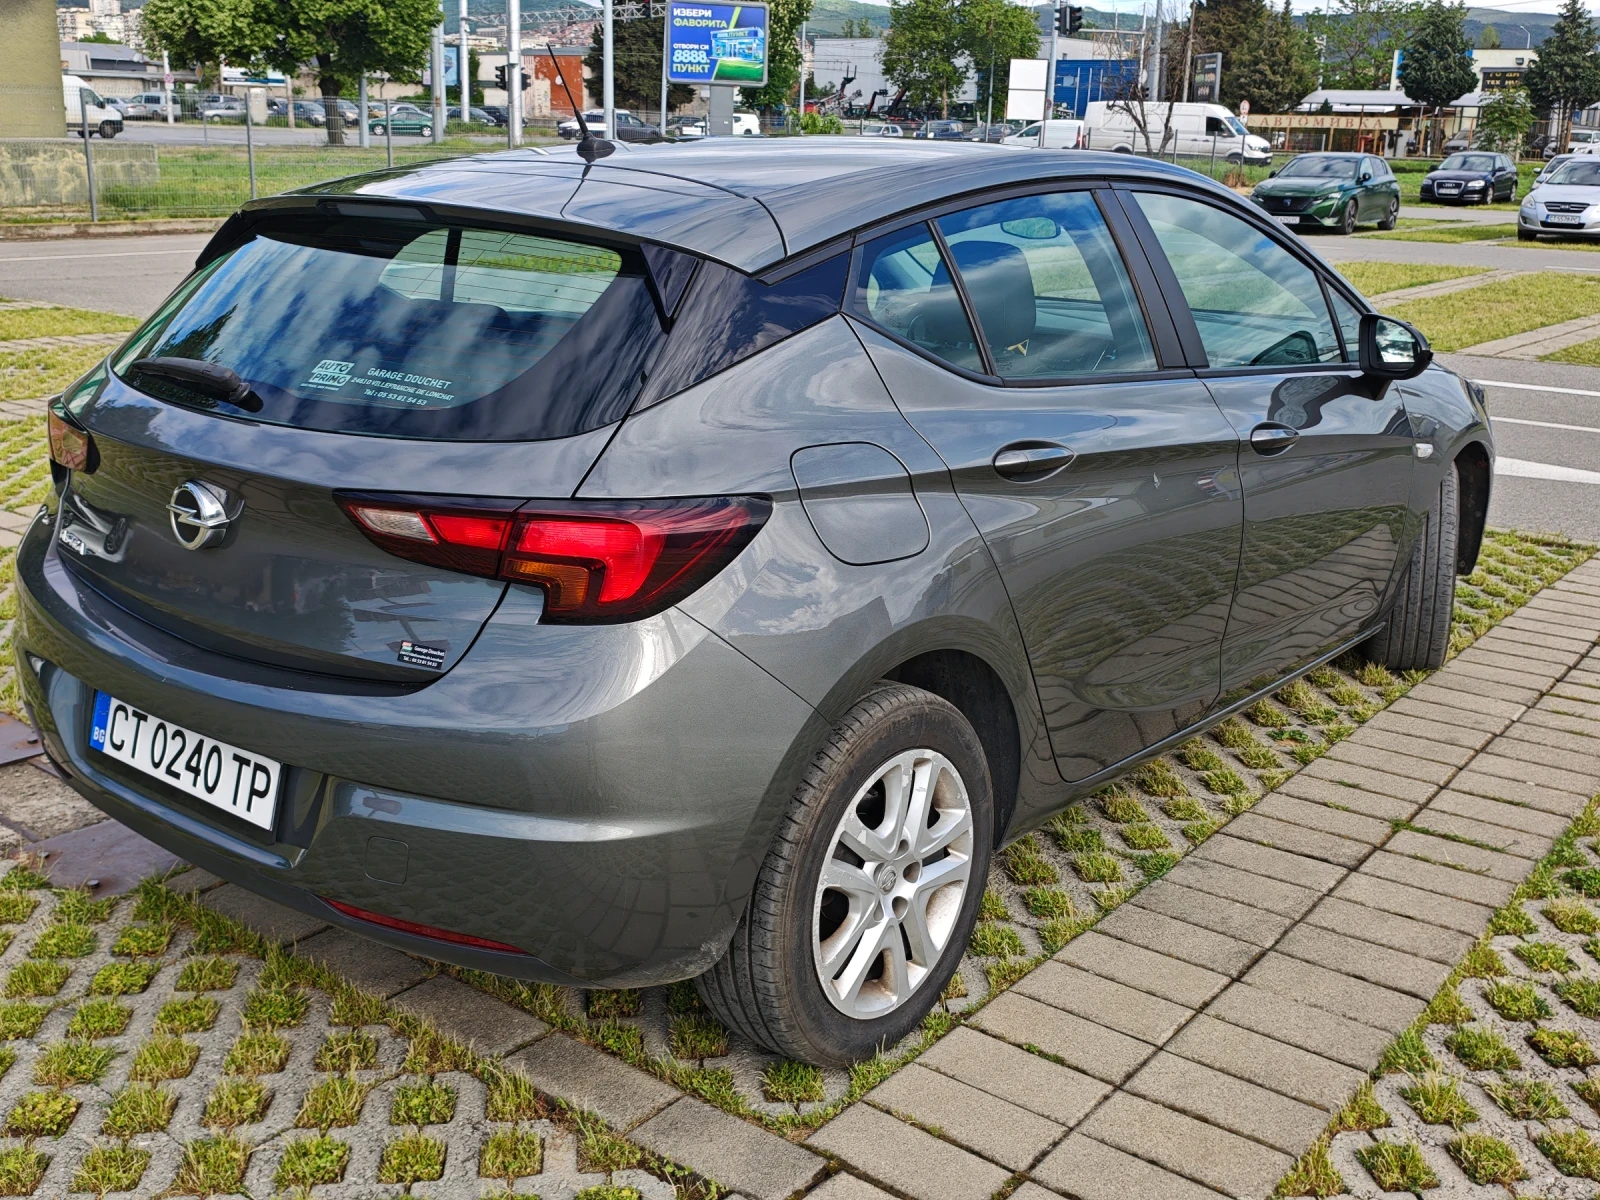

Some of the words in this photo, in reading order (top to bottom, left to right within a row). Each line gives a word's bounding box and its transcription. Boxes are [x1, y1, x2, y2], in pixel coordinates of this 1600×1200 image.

[673, 8, 712, 17] ИЗБЕРИ
[673, 18, 728, 28] ФАВОРИТА
[673, 64, 710, 73] ПУНКТ
[1260, 117, 1383, 128] АВТОМИВКА
[316, 361, 351, 372] AUTO
[311, 372, 348, 385] PRIMO
[367, 367, 405, 381] GARAGE
[404, 373, 452, 389] DOUCHET
[371, 380, 417, 394] VILLEFRANCHE
[415, 388, 427, 396] DE
[425, 390, 455, 401] LONCHAT
[93, 726, 106, 743] BG
[109, 704, 149, 760] CT
[151, 722, 223, 795] 0240
[232, 752, 272, 813] TP
